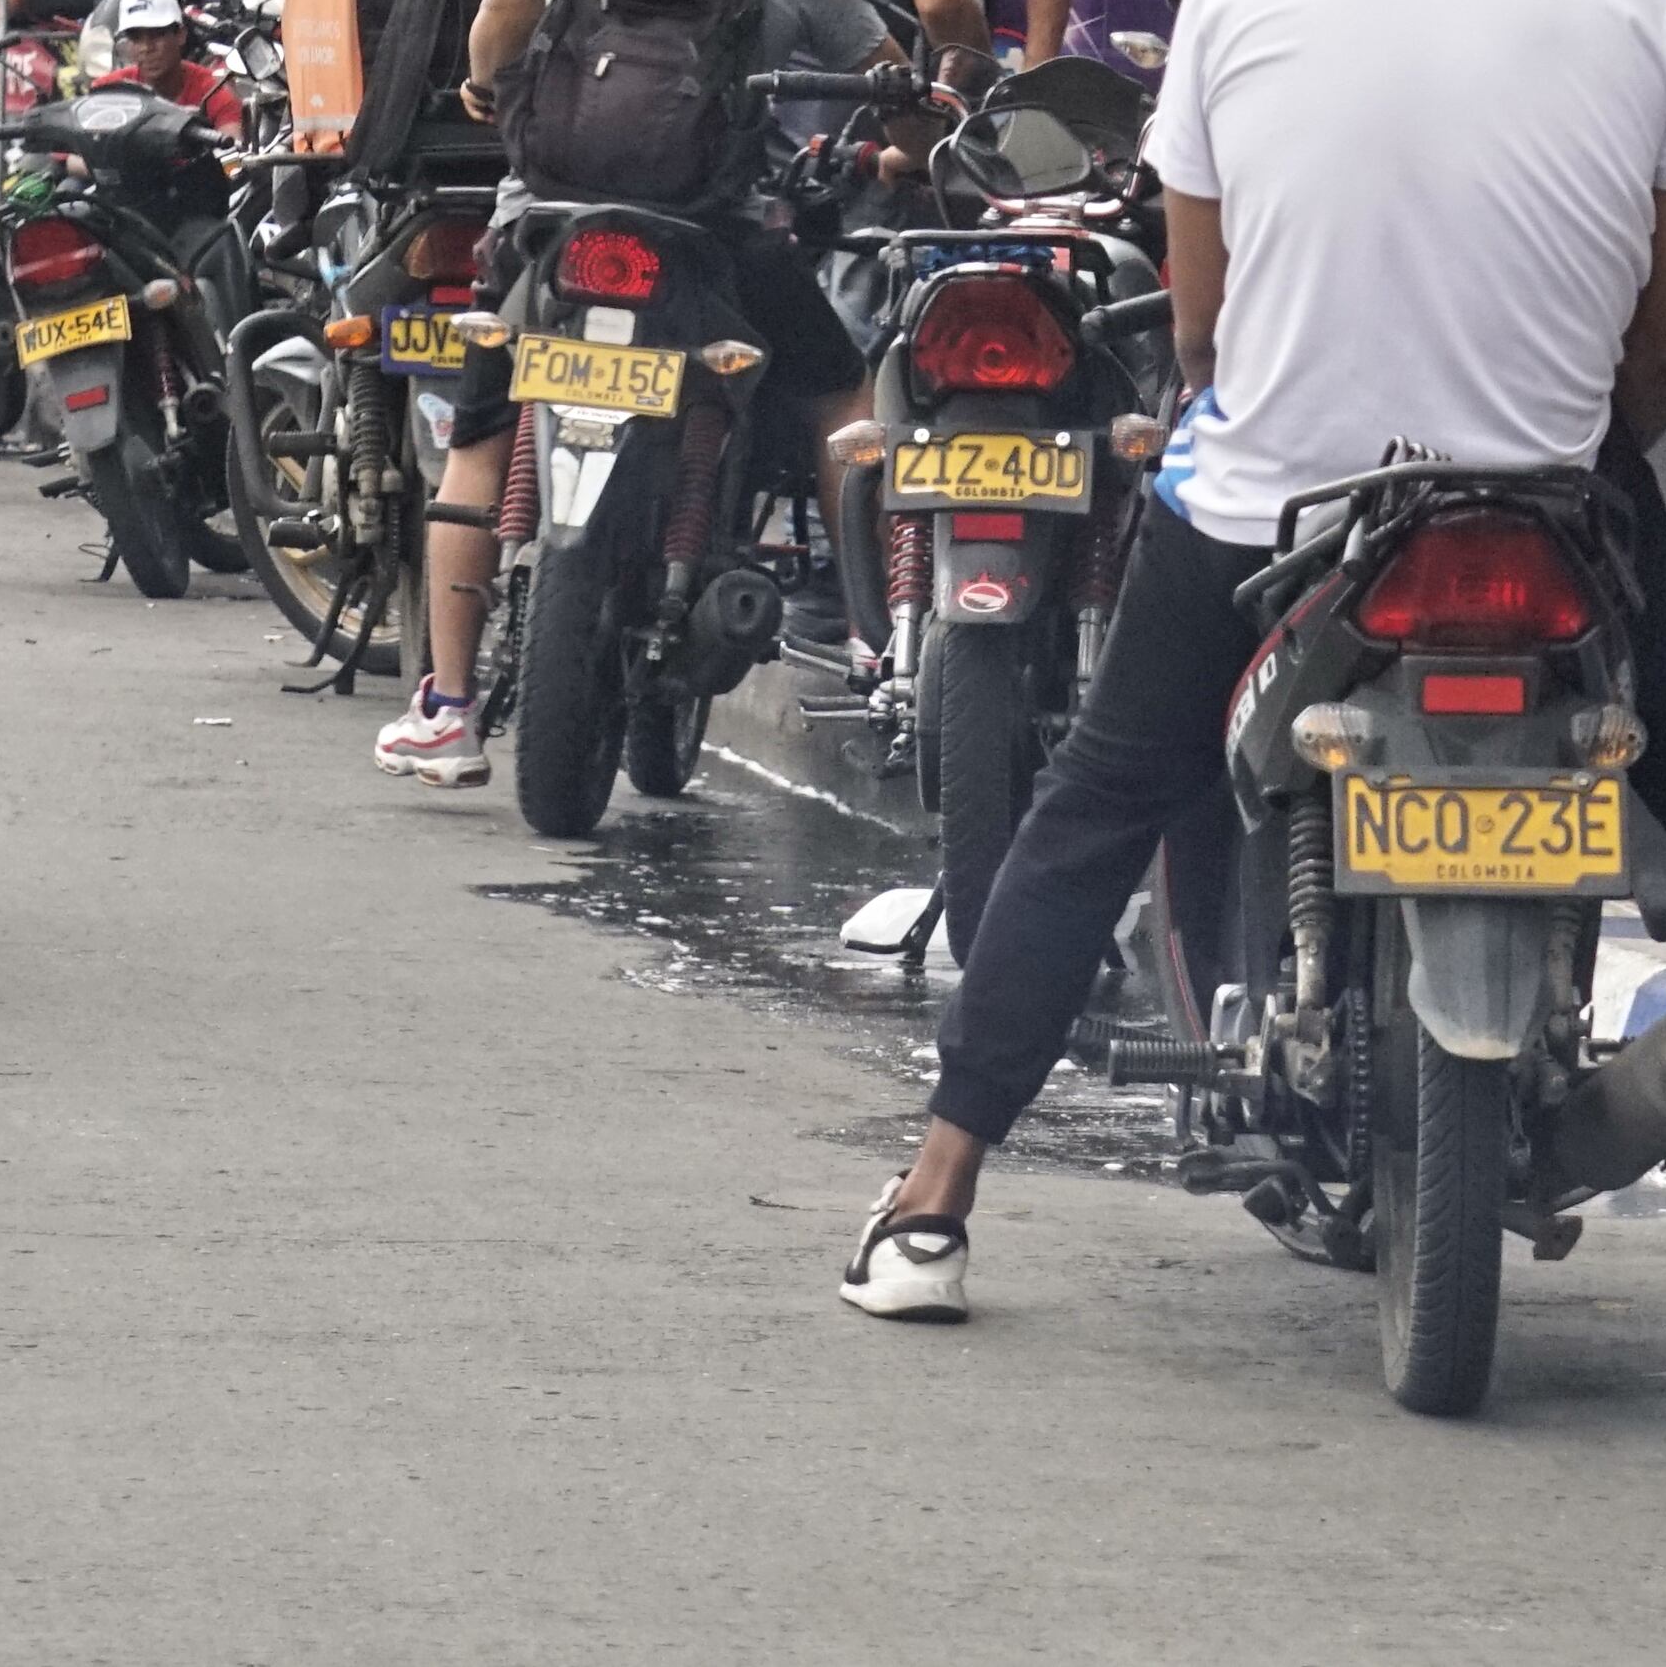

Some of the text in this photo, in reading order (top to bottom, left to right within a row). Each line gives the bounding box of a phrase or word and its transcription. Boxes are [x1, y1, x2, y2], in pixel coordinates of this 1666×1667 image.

[76, 305, 124, 335] 54E
[954, 485, 1026, 499] COLOMBIA
[1353, 790, 1614, 857] NCQ 23E
[1436, 863, 1537, 880] COLOMBIA
